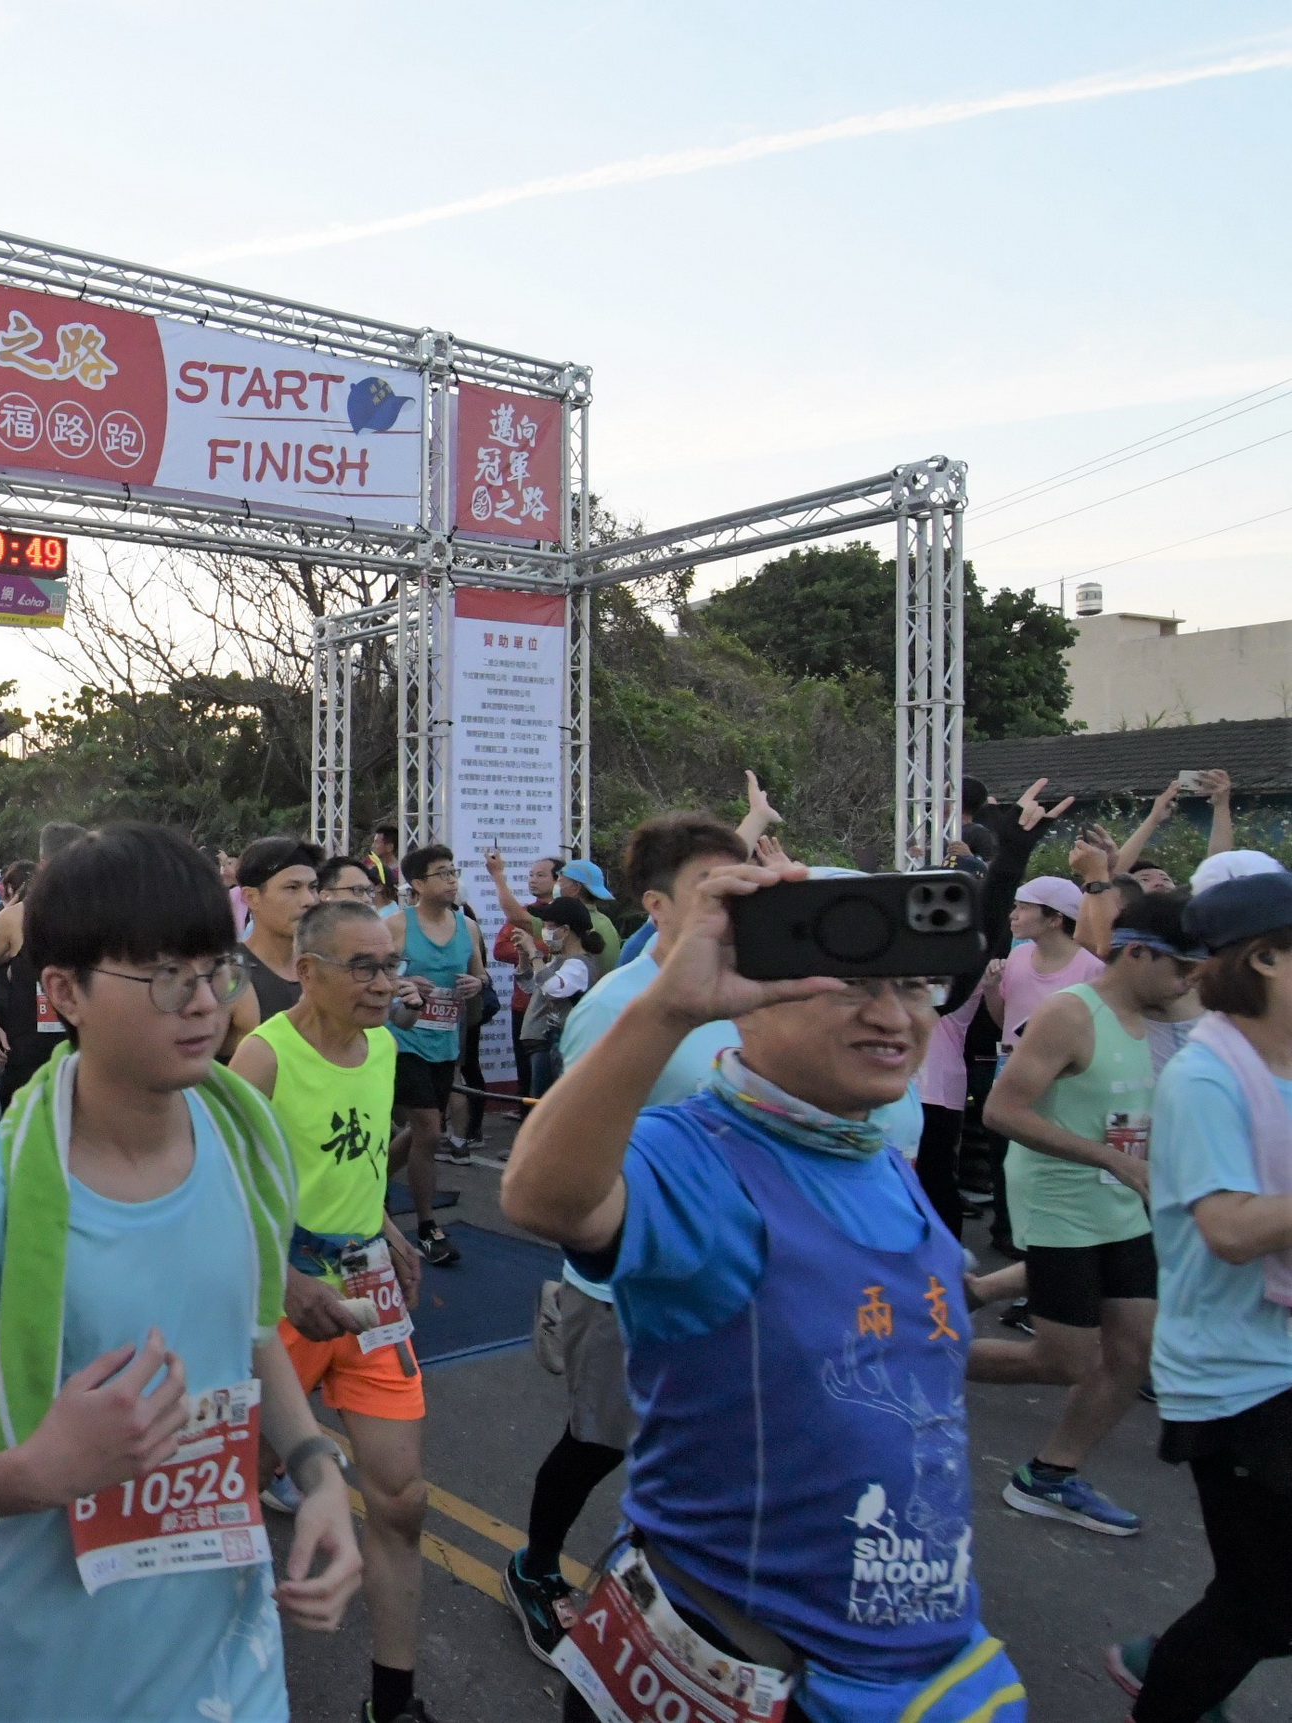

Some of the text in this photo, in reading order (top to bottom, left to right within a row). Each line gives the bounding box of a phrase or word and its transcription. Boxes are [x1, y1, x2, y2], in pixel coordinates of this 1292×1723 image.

[175, 360, 345, 413] START
[488, 402, 539, 448] 邁向
[207, 438, 369, 487] FINISH
[476, 446, 532, 492] 冠軍
[495, 485, 550, 525] 之路
[18, 593, 45, 608] Lohas
[425, 1003, 458, 1017] 10873
[120, 1455, 245, 1518] 10526
[852, 1537, 923, 1562] SUN
[853, 1558, 949, 1585] MOON
